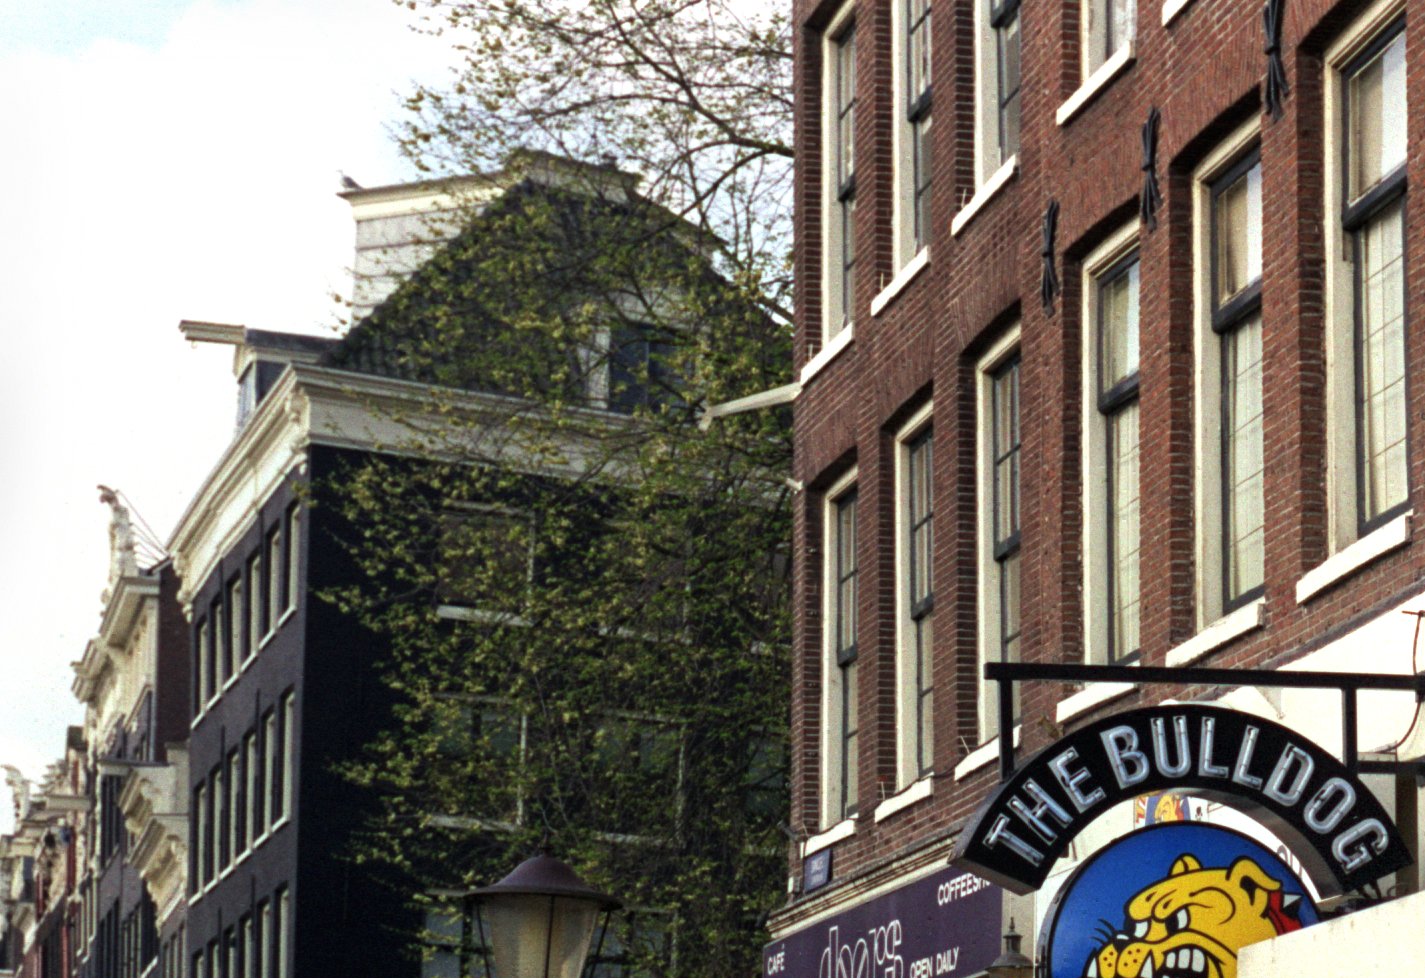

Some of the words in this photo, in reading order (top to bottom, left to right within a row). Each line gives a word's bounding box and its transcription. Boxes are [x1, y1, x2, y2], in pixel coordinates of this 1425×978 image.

[982, 746, 1106, 868] THE
[1100, 715, 1390, 875] BULLDOG
[767, 944, 785, 975] CAFÉ
[936, 946, 960, 976] DAILY
